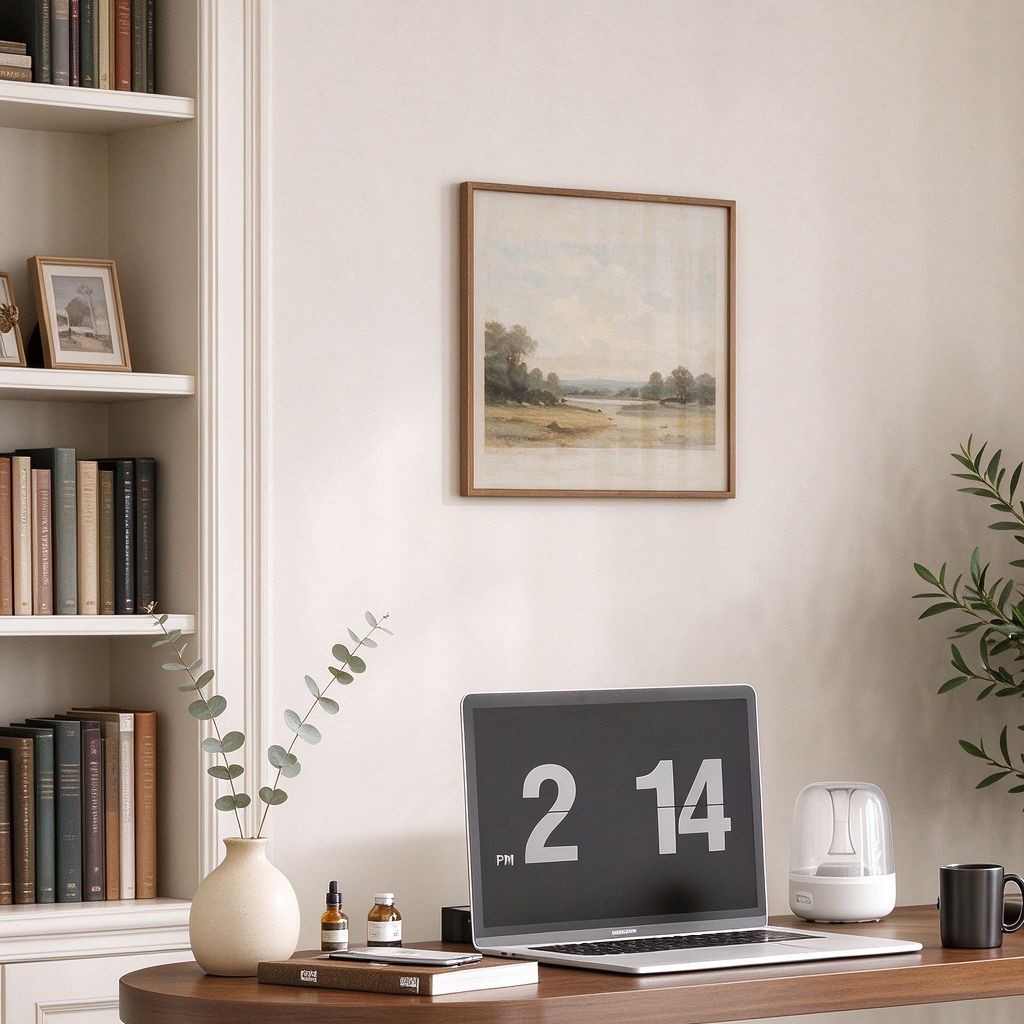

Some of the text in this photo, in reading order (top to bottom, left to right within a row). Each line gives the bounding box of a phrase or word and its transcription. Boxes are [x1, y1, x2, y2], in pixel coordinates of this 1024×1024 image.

[522, 758, 732, 865] 2 14
[496, 854, 515, 867] PM
